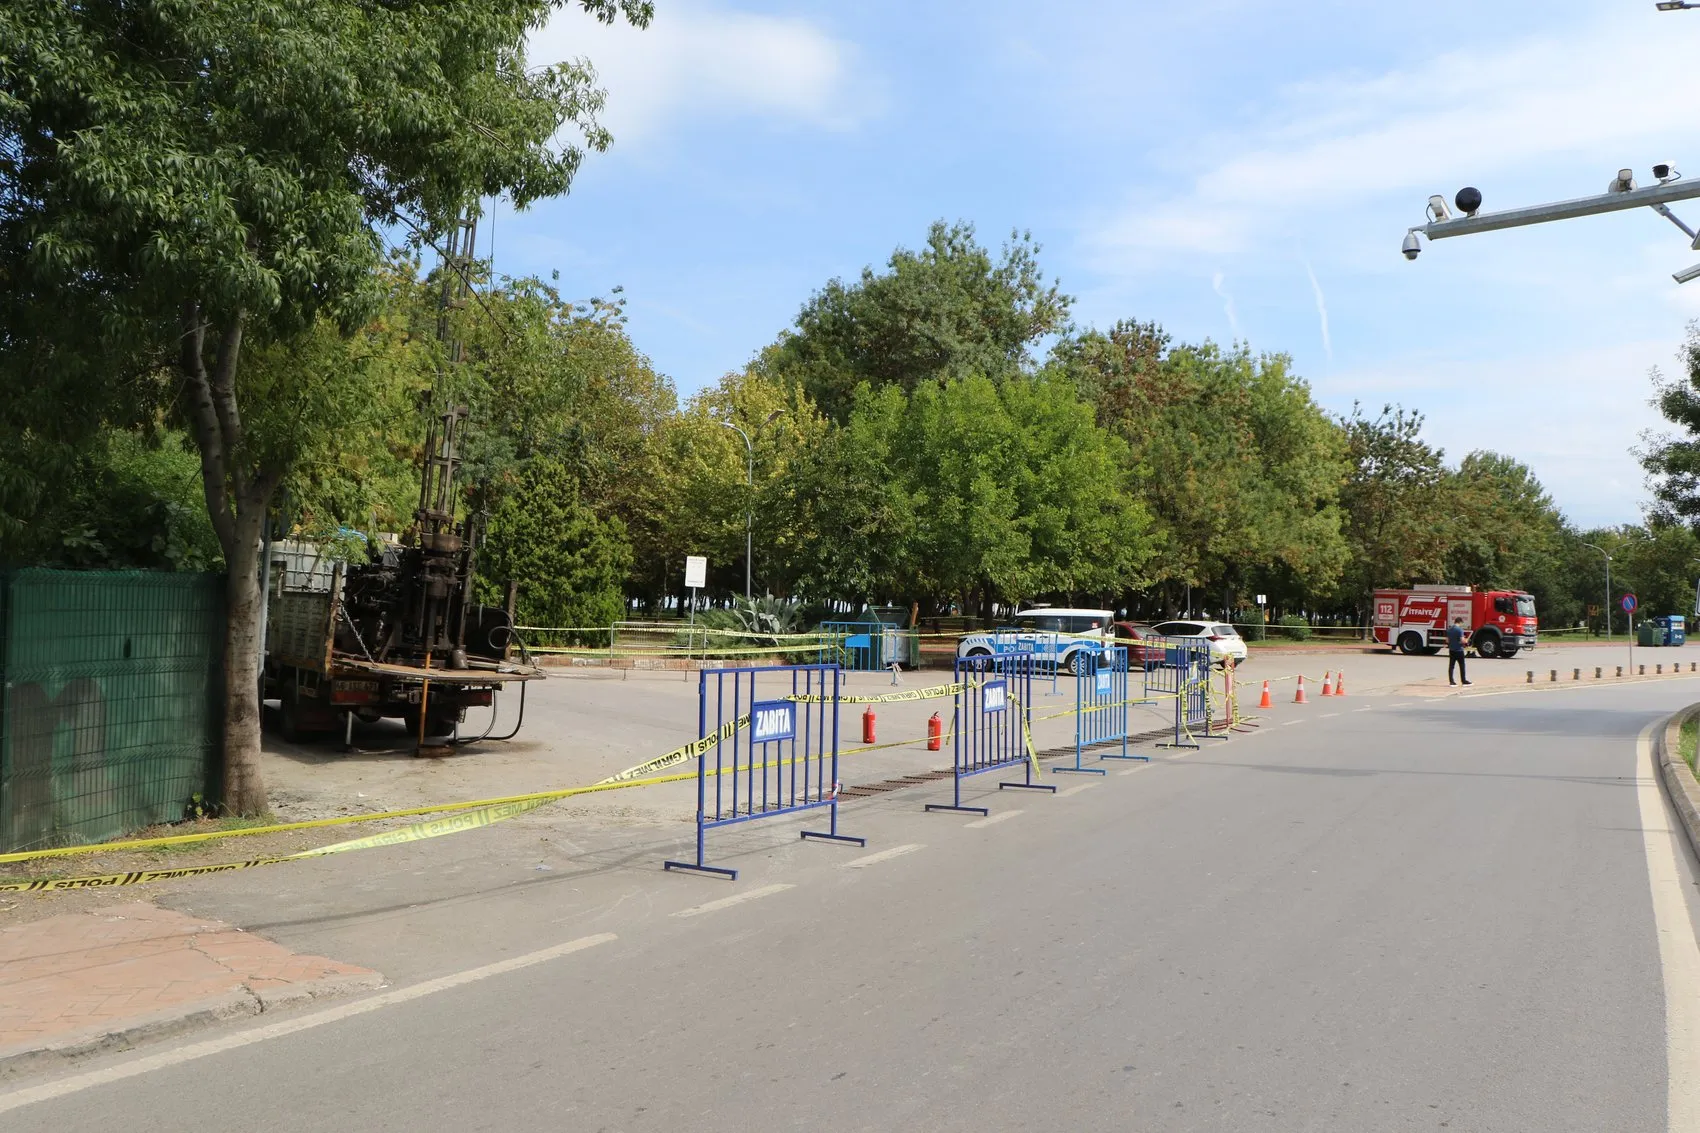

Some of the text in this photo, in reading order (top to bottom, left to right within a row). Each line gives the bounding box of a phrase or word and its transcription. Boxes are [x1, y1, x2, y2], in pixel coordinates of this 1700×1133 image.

[1380, 604, 1392, 614] 112
[1408, 608, 1433, 616] İTFAİYE
[756, 708, 791, 737] ZABITA
